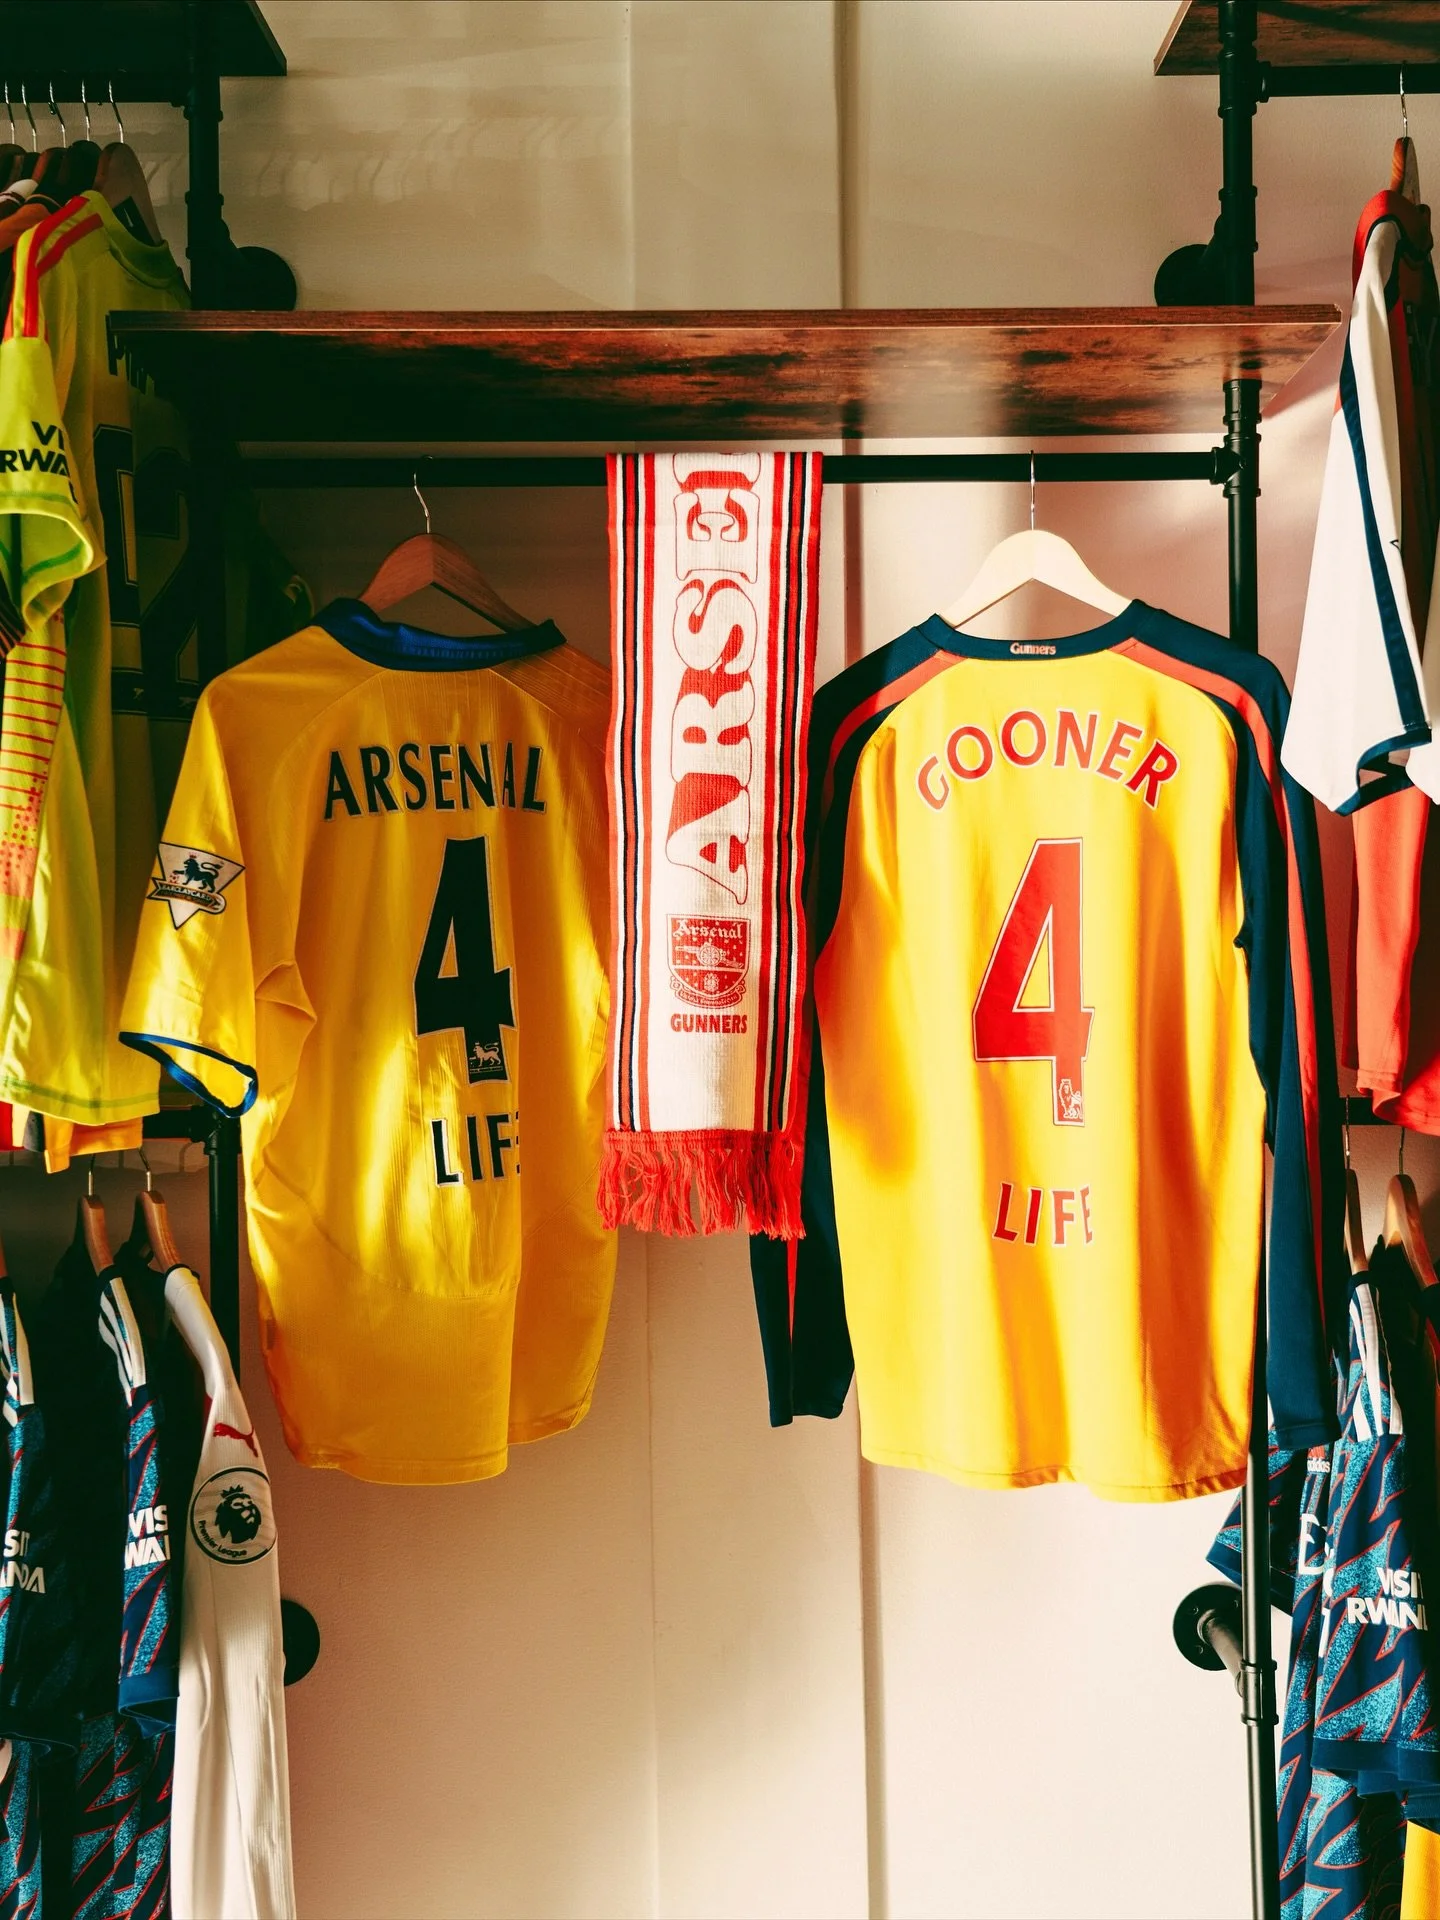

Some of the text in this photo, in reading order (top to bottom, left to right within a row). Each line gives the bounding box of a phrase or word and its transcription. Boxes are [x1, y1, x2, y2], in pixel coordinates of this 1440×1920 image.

[1010, 642, 1056, 655] Gunners
[323, 741, 547, 822] ARSENAL
[916, 707, 1182, 812] GOONER
[672, 919, 743, 939] Arsenal
[413, 836, 518, 1087] 4
[971, 837, 1095, 1128] 4
[670, 1013, 748, 1034] GUNNERS
[430, 1111, 520, 1188] LIF
[199, 1520, 248, 1558] Premier League
[1376, 1566, 1424, 1600] VISI
